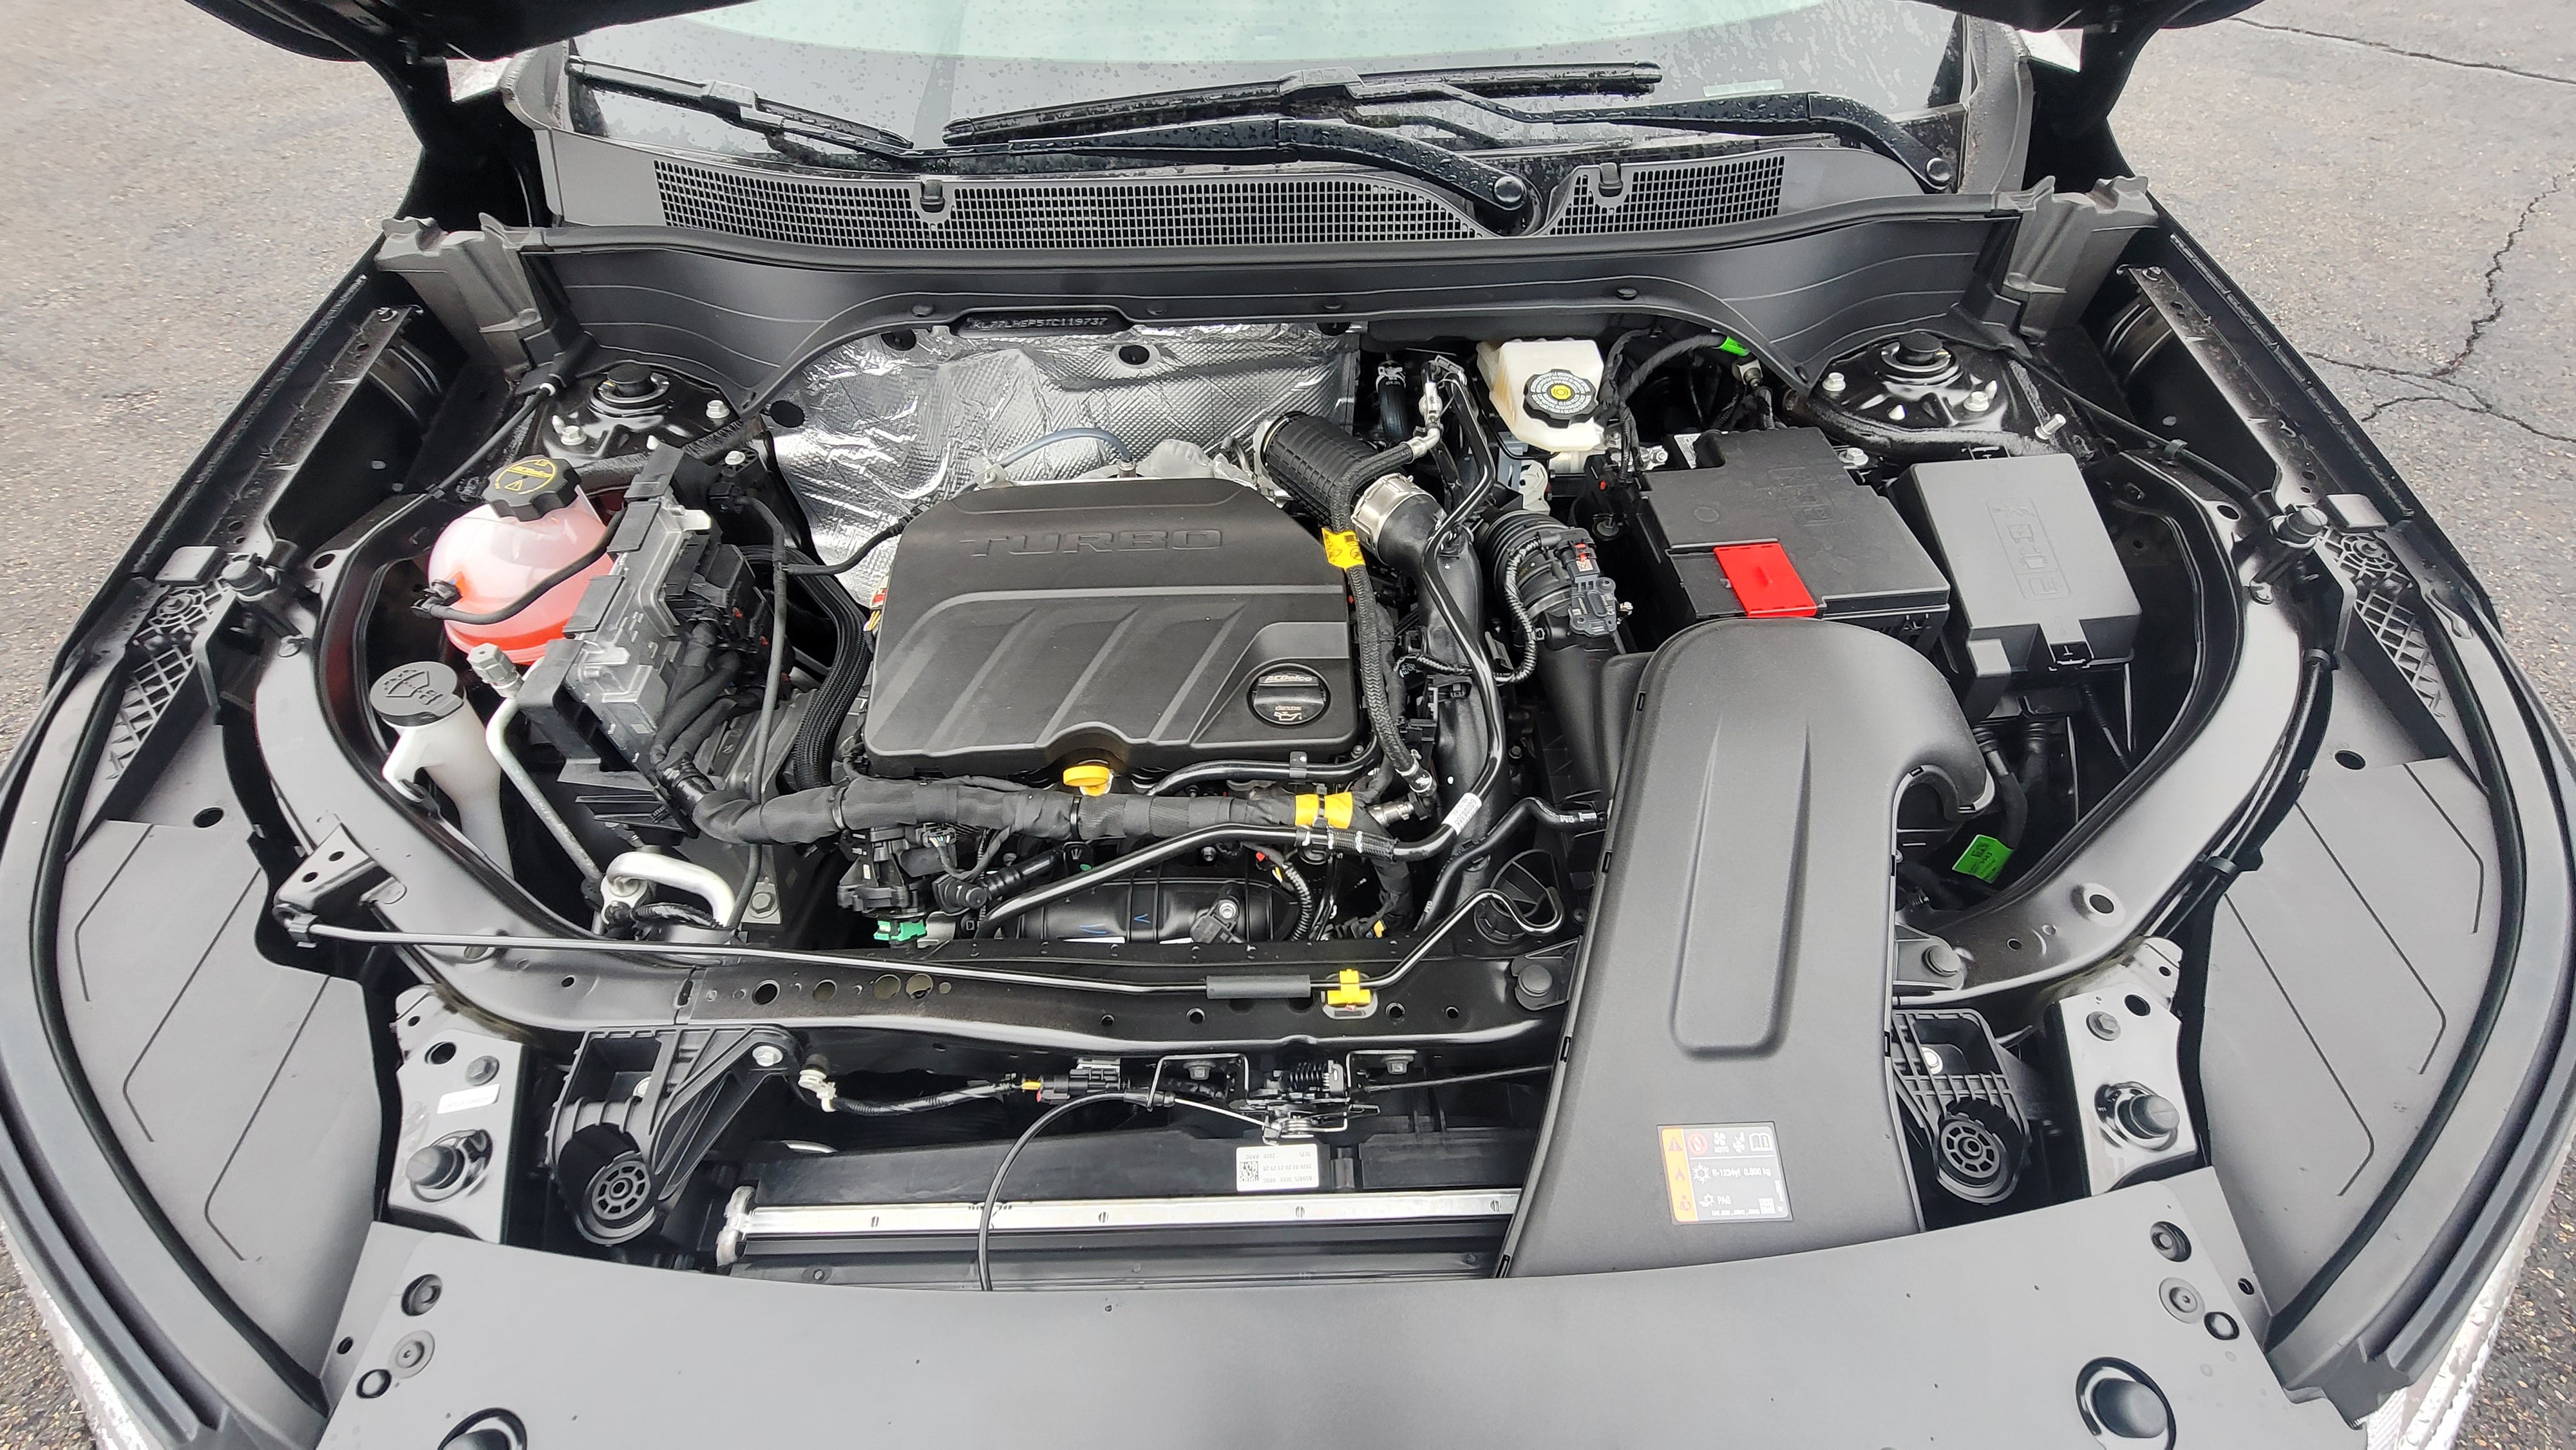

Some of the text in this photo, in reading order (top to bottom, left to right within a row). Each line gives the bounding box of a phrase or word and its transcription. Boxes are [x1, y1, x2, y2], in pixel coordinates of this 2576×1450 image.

[973, 317, 1108, 329] KL77LHEP5TC119737
[958, 529, 1222, 557] TURBO
[1762, 1167, 1772, 1177] kg
